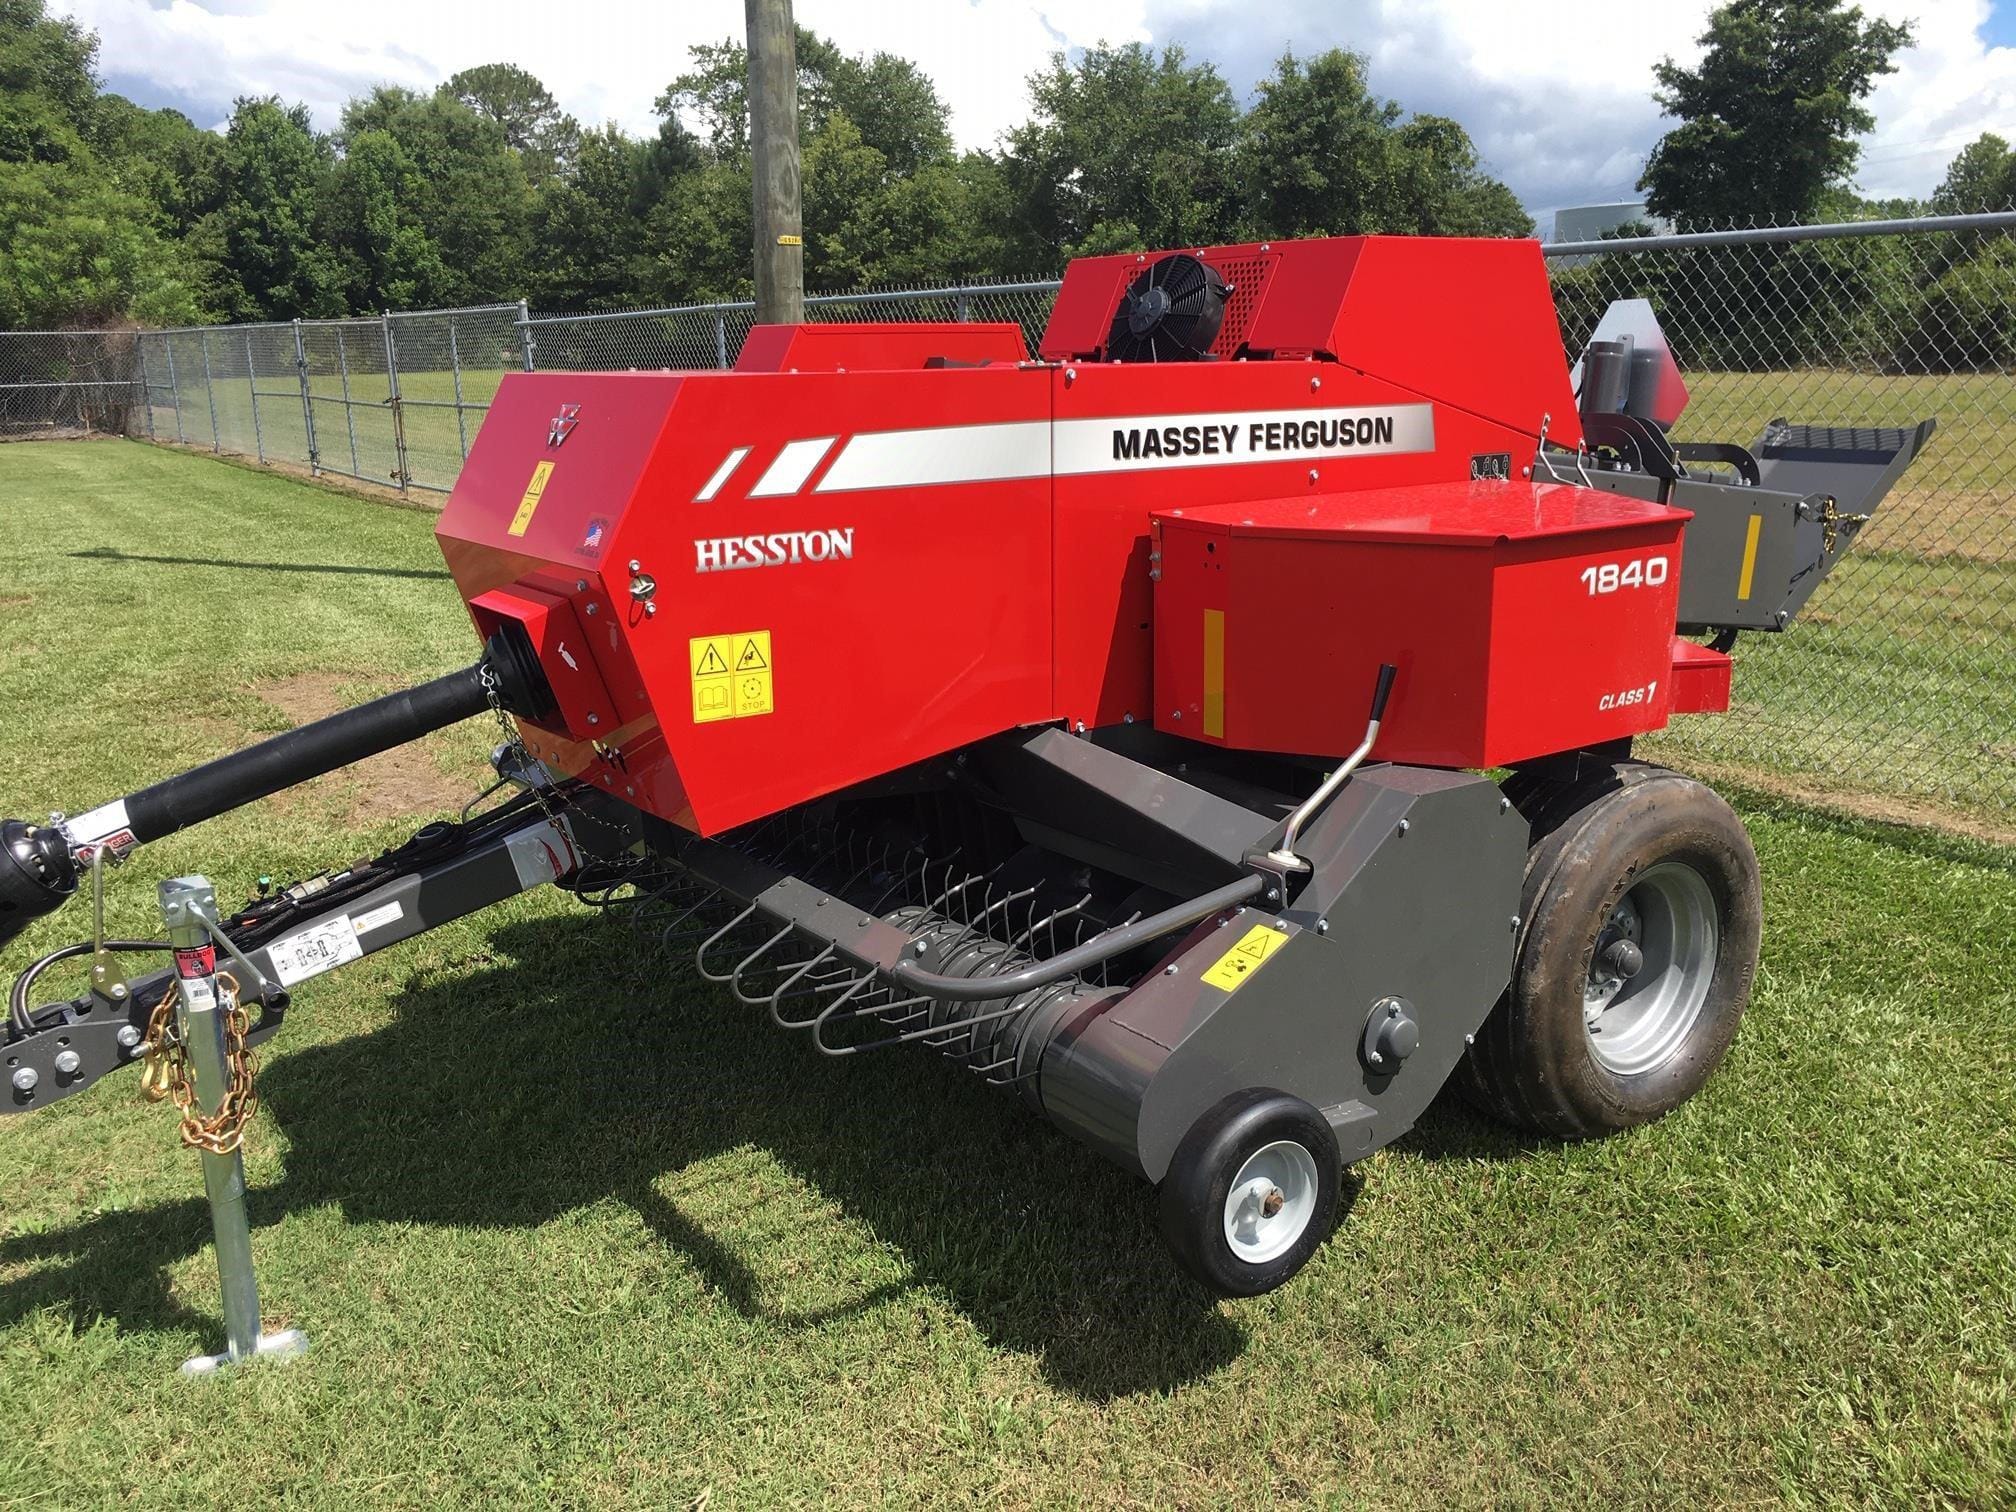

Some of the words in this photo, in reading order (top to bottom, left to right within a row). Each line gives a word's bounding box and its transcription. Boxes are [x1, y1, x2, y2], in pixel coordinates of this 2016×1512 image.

[1112, 423, 1240, 459] MASSEY
[1248, 416, 1395, 451] FERGUSON
[694, 528, 855, 573] HESSTON
[1580, 556, 1668, 596] 1840
[741, 700, 765, 711] STOP
[1599, 688, 1645, 711] CLASS
[1647, 681, 1657, 705] 1
